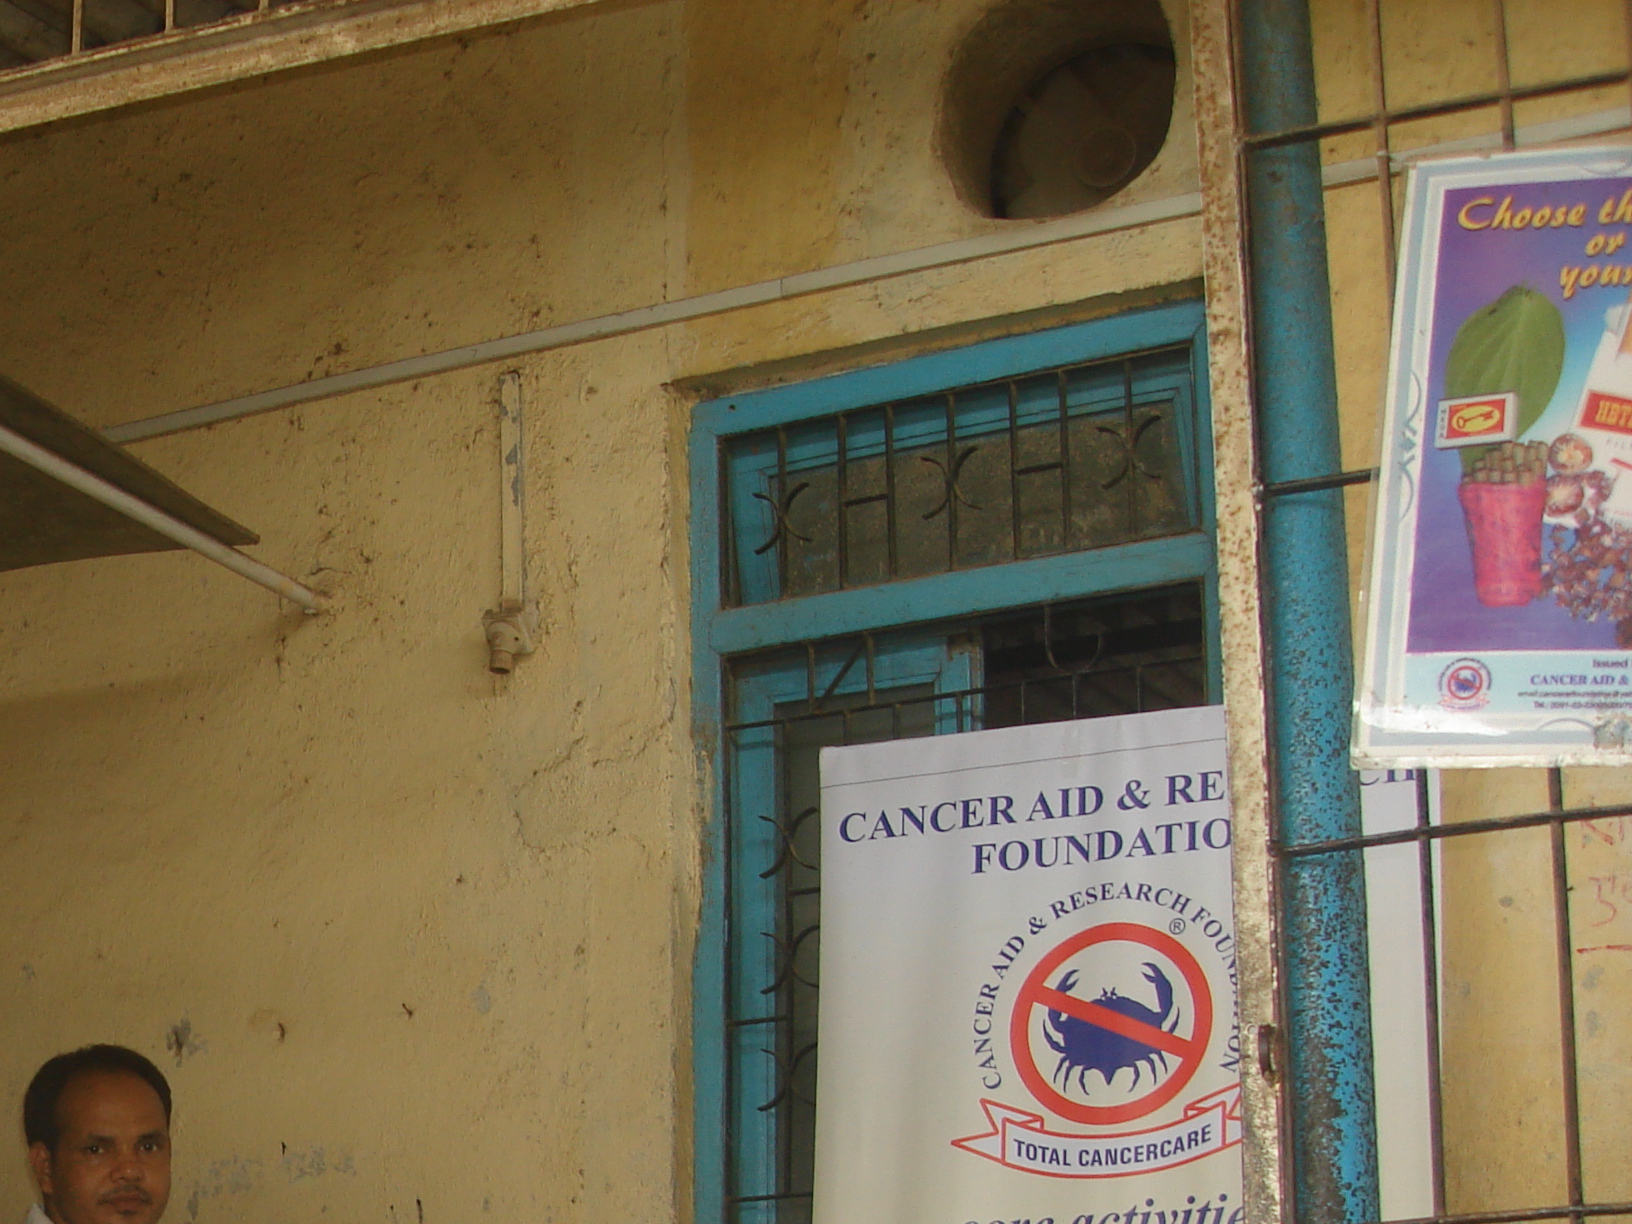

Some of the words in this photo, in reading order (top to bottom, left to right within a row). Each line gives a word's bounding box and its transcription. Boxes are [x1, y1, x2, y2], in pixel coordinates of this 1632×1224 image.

[1458, 195, 1587, 230] Choose
[1584, 232, 1626, 257] or
[1530, 674, 1587, 685] CANCER
[1591, 674, 1614, 685] AID
[1618, 674, 1629, 685] &
[839, 794, 1016, 843] CANCER
[1026, 785, 1104, 822] AID
[1116, 779, 1151, 810] &
[973, 984, 1002, 1090] CANCER
[991, 935, 1025, 979] AID
[1028, 916, 1046, 935] &
[1049, 882, 1191, 920] RESEARCH
[1014, 1138, 1071, 1166] TOTAL
[1078, 1124, 1212, 1167] CANCERCARE
